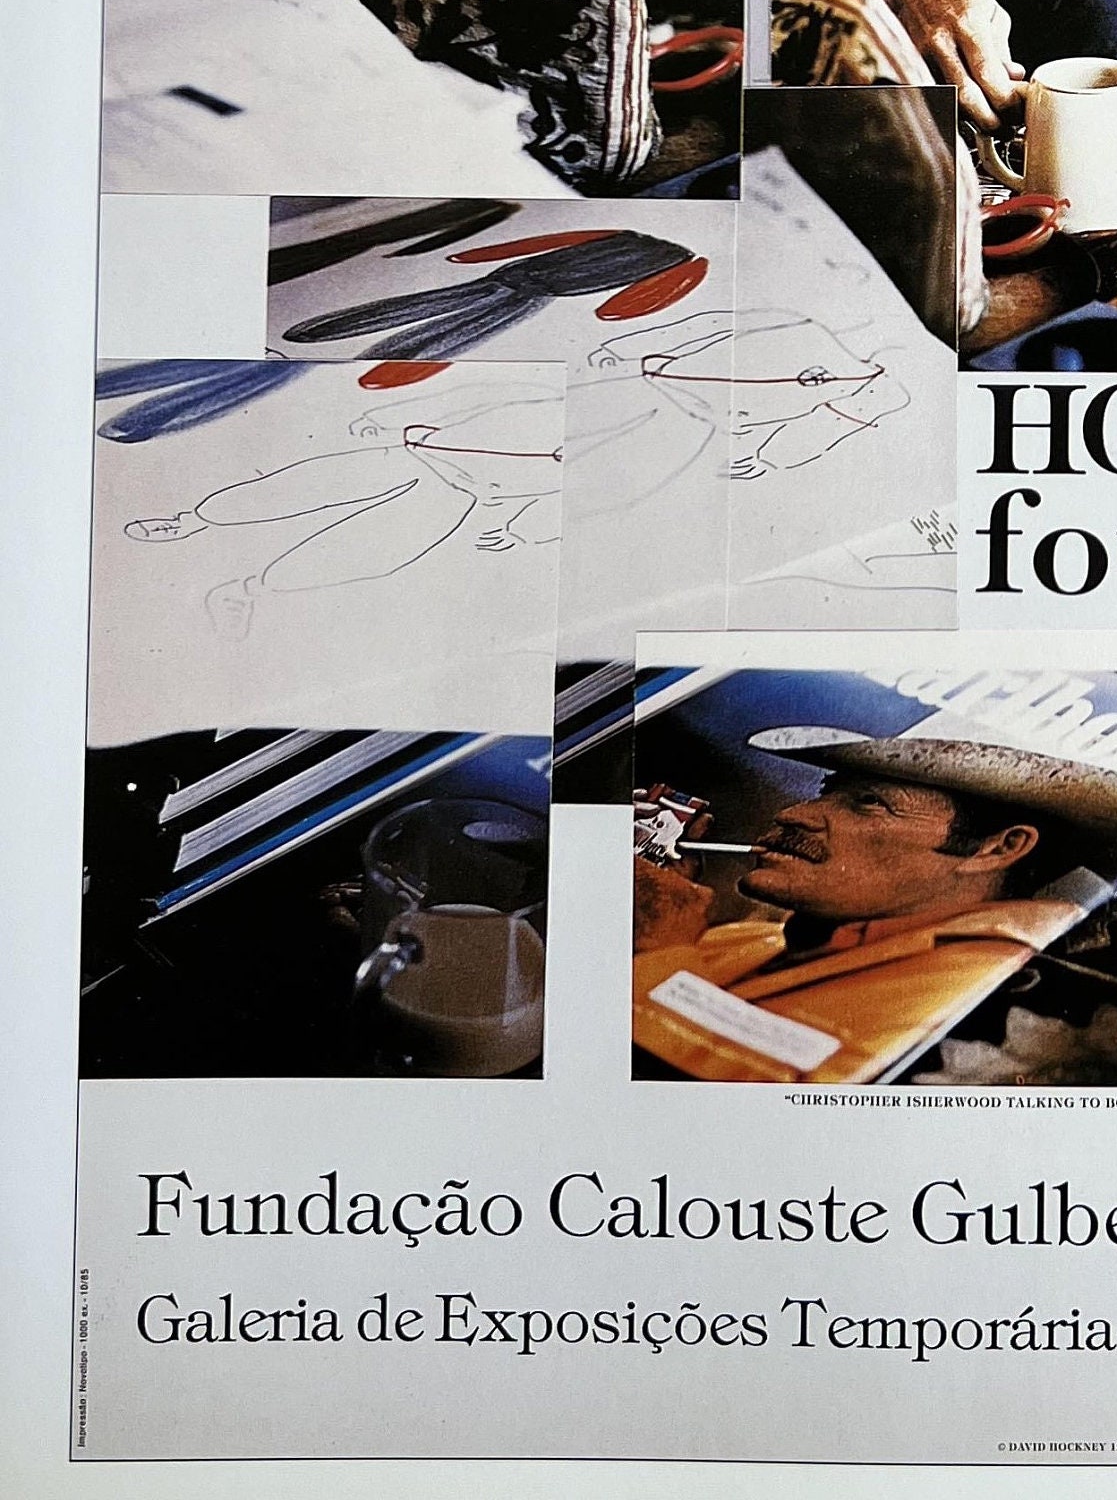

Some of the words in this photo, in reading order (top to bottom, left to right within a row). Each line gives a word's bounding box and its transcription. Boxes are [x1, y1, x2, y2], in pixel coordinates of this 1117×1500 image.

[906, 1095, 1002, 1108] ISHERWOOD
[1005, 1096, 1075, 1109] TALKING
[1079, 1097, 1101, 1109] TO
[137, 1171, 522, 1249] Fundação
[549, 1172, 889, 1244] Calouste
[80, 1268, 90, 1296] 10/85
[79, 1319, 89, 1343] 1000
[137, 1292, 343, 1344] Galeria
[357, 1293, 425, 1342] de
[434, 1292, 768, 1356] Exposições
[1008, 1442, 1046, 1452] DAVID
[1049, 1442, 1107, 1452] HOCKNEY
